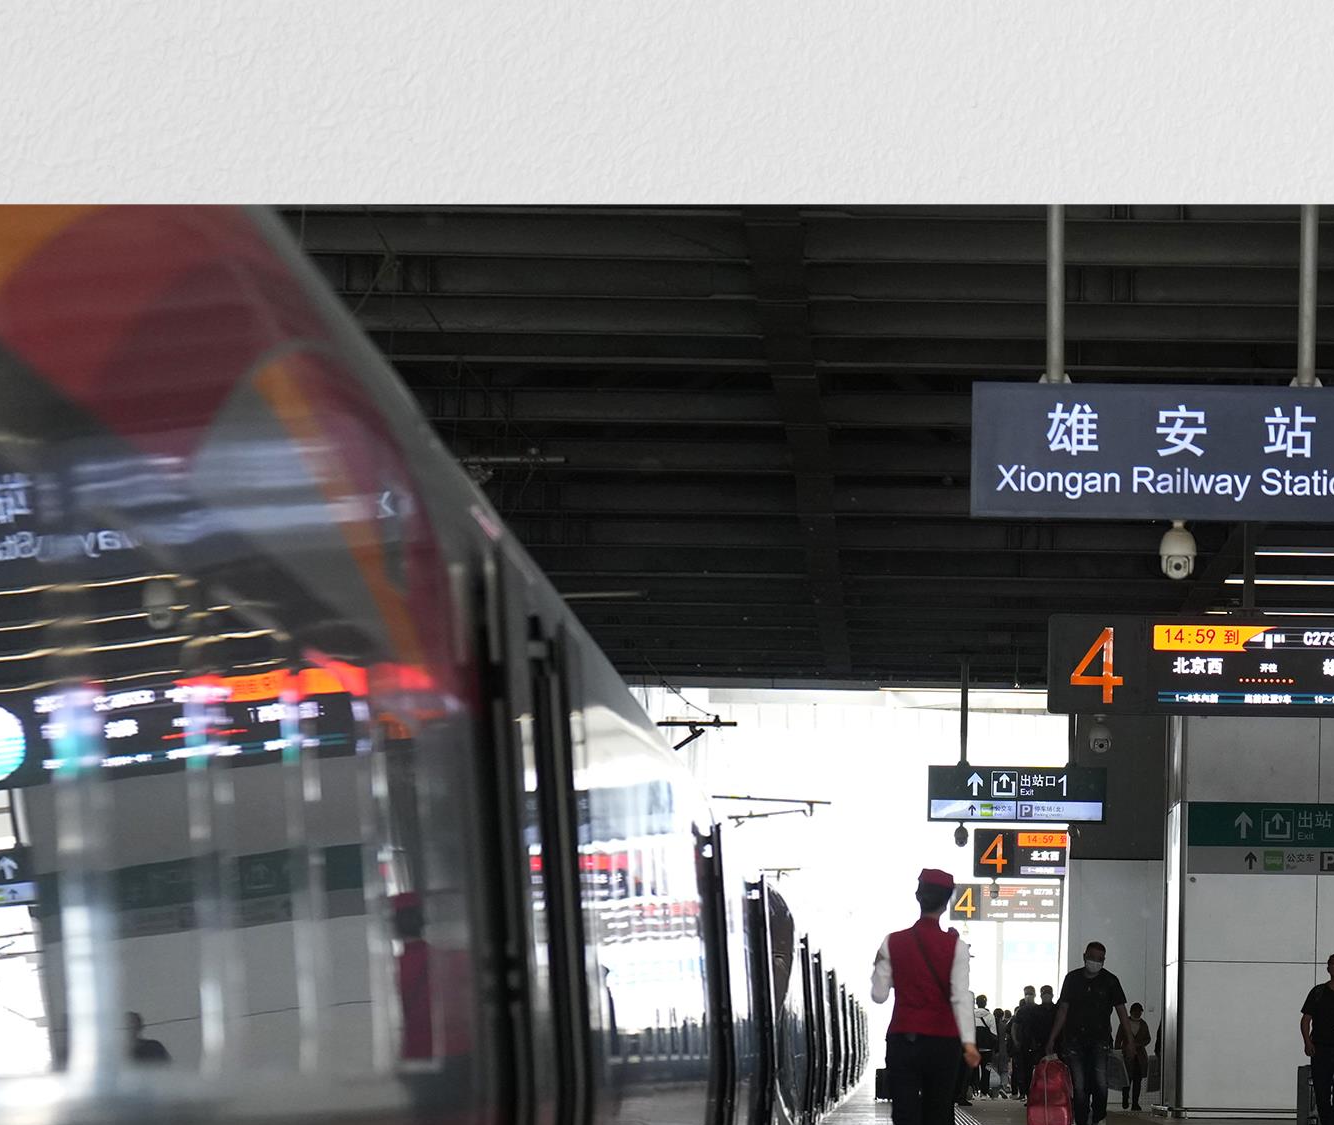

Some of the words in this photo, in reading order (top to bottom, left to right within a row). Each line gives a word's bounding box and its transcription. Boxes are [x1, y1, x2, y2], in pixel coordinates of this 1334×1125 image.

[1047, 402, 1316, 459] 雄安站
[996, 464, 1120, 500] Xiongan
[1132, 466, 1251, 501] Railway
[1165, 629, 1216, 644] 14:59
[1224, 630, 1239, 645] 到
[1070, 627, 1124, 704] 4
[1173, 657, 1223, 675] 北京西
[1020, 788, 1034, 796] Exit
[1027, 836, 1053, 844] 14:59
[1298, 832, 1314, 840] Exit
[980, 834, 1007, 873] 4
[1286, 854, 1315, 863] 公交车
[955, 888, 975, 917] 4
